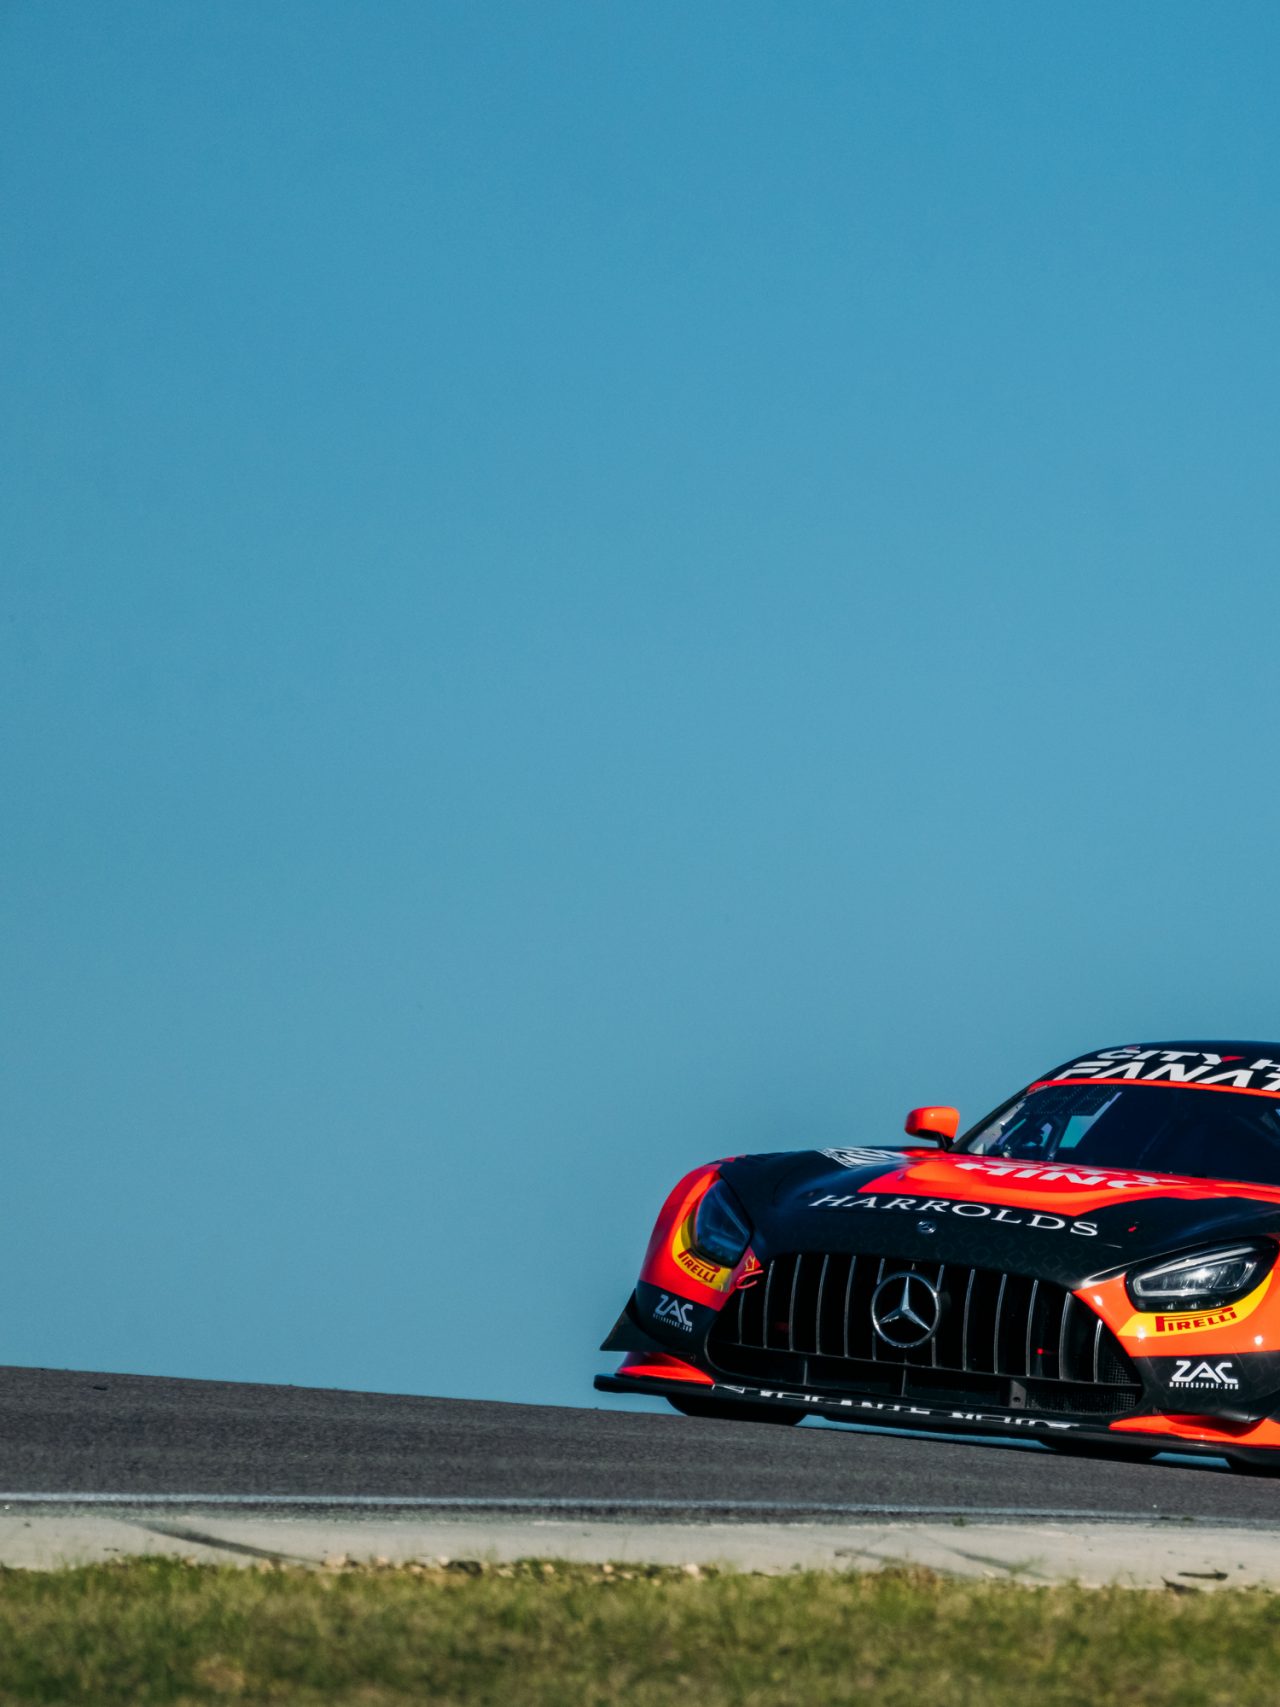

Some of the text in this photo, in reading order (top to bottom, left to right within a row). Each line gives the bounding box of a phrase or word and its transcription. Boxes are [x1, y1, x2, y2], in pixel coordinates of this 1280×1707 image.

[1097, 1046, 1246, 1065] CITY
[808, 1194, 1099, 1237] HARROLDS
[678, 1249, 721, 1284] PIRELLI
[655, 1294, 694, 1327] ZAC
[1155, 1306, 1237, 1332] PIRELLI
[1171, 1359, 1239, 1384] ZAC
